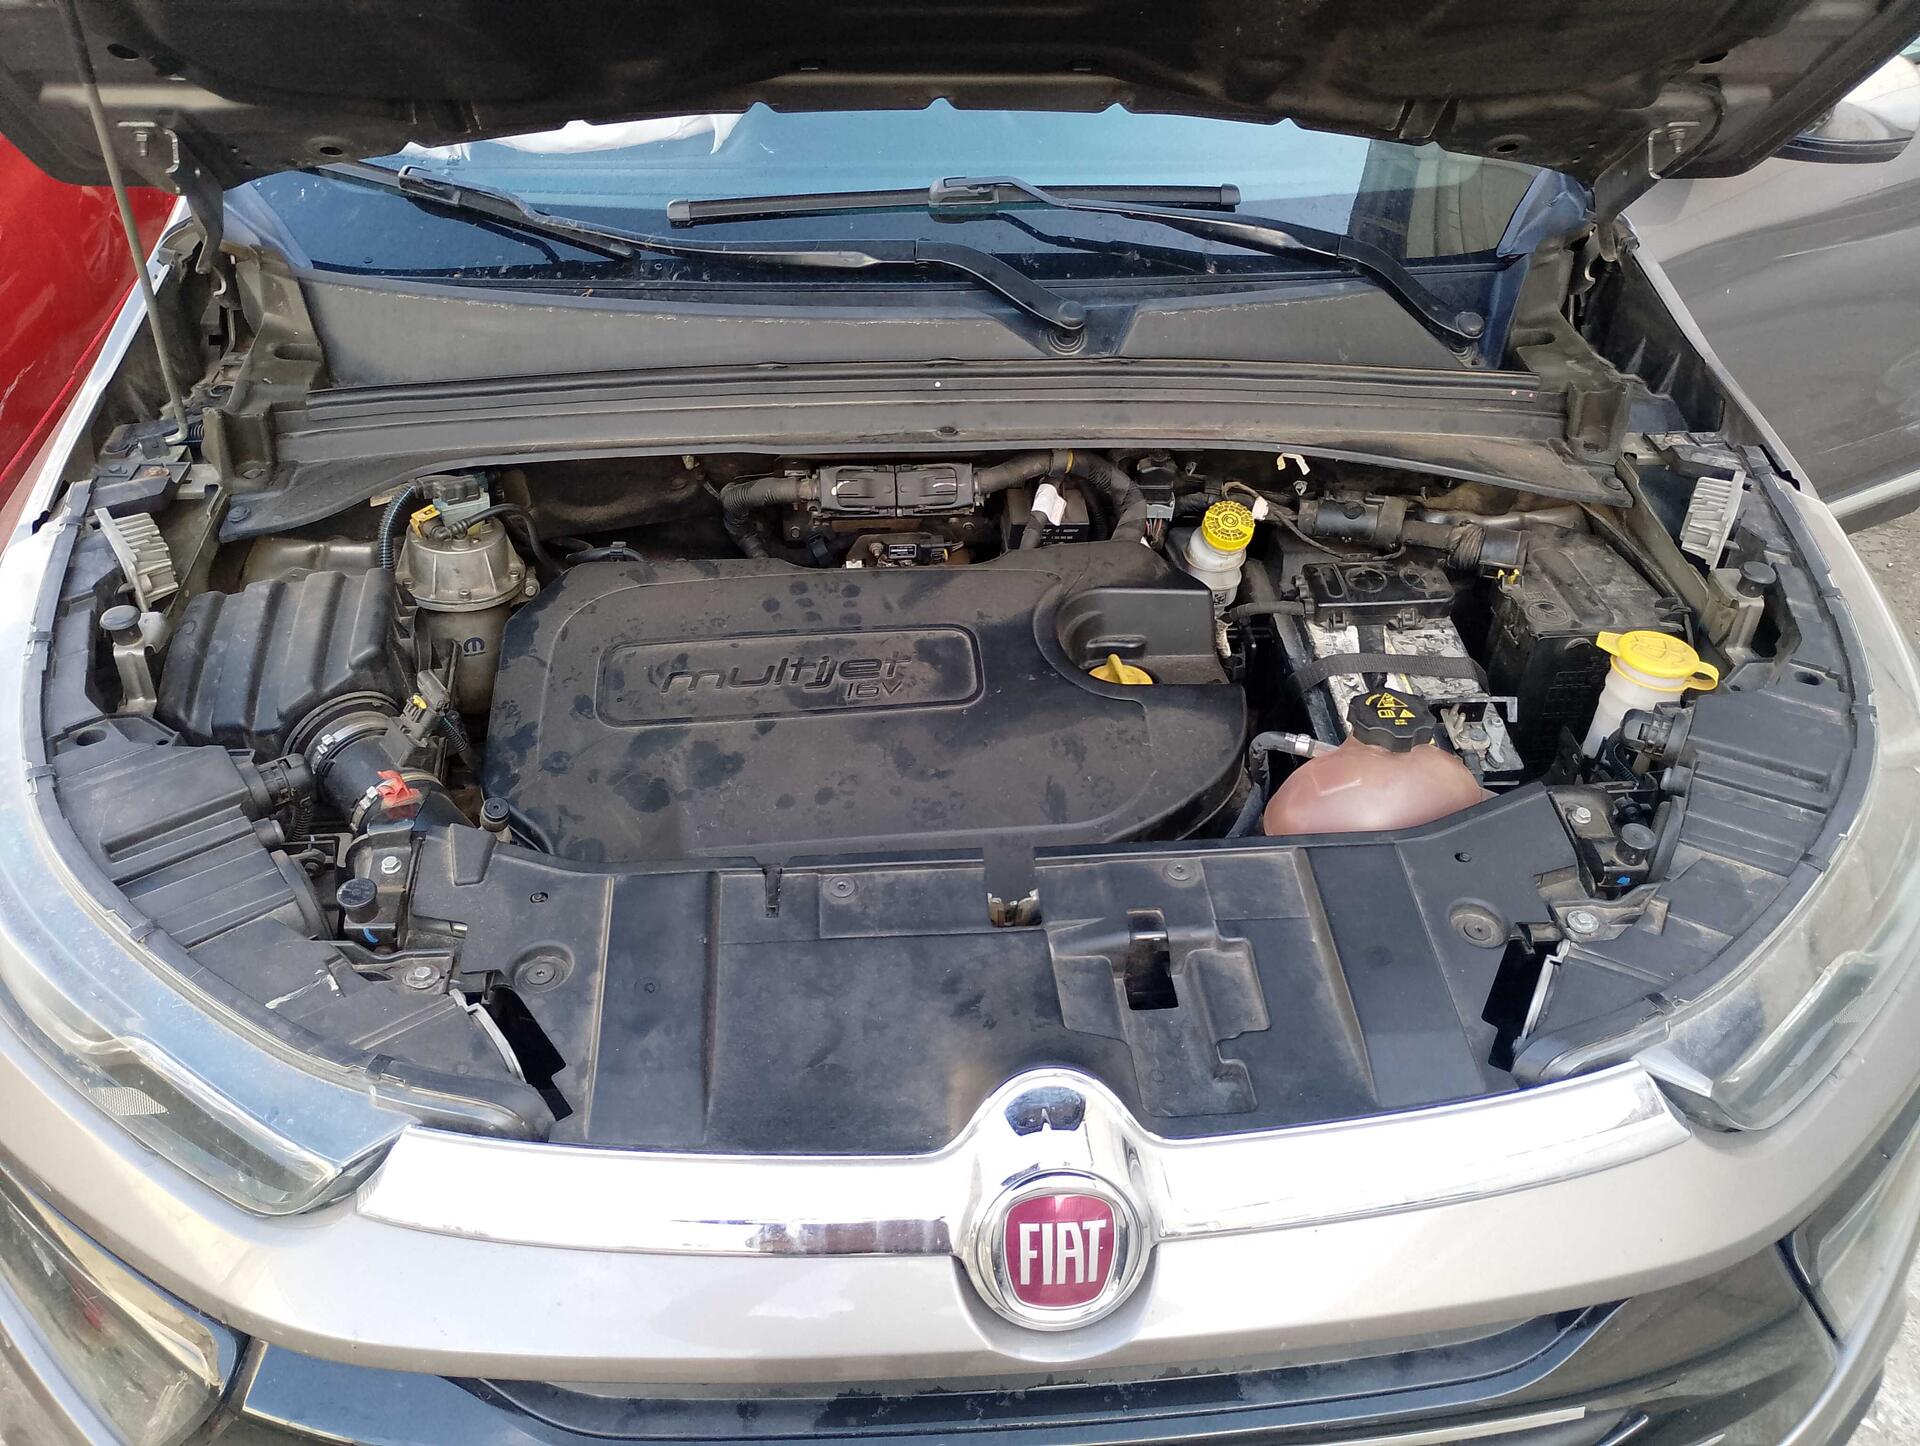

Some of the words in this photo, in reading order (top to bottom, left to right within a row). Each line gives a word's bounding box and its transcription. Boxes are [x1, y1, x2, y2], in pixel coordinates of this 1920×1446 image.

[660, 654, 912, 694] multijet
[846, 680, 903, 698] 16V
[1018, 1219, 1107, 1286] FIAT
